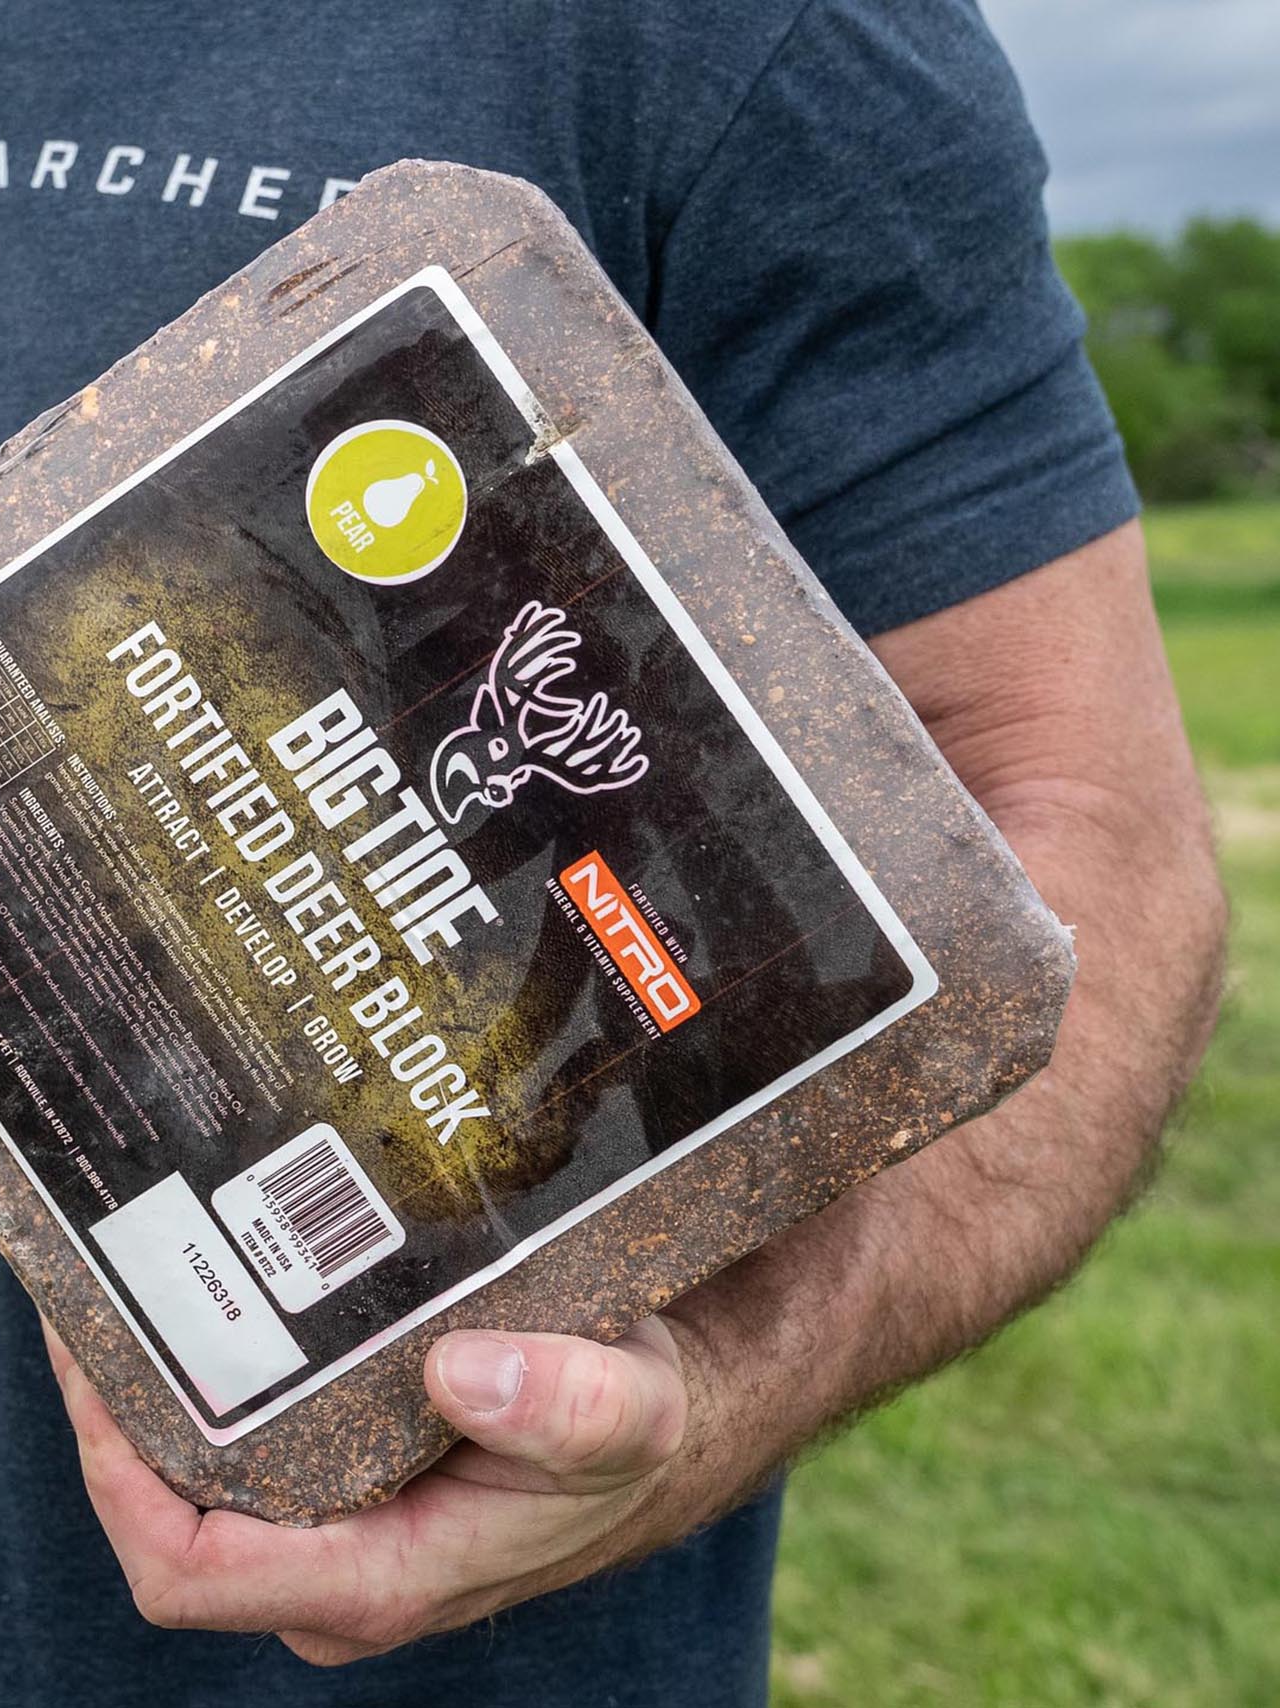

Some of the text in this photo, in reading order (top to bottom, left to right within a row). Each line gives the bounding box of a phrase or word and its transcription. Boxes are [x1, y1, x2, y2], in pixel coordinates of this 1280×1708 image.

[328, 499, 376, 553] PEAR
[28, 696, 68, 747] ANALYSIS:
[55, 761, 80, 792] heavily
[66, 753, 119, 823] INSTRUCTIONS:
[75, 789, 92, 810] used
[86, 808, 106, 831] trails,
[264, 686, 499, 967] BIG TINE
[101, 829, 121, 853] water
[128, 843, 147, 866] block
[104, 619, 491, 1146] FORTIFIED DEER BLOCK
[142, 865, 154, 876] in
[146, 874, 167, 898] spots
[137, 882, 148, 893] or
[41, 895, 68, 928] Copper
[142, 891, 168, 922] staging
[160, 893, 195, 938] frequented
[20, 883, 36, 902] and
[31, 900, 56, 932] Natural
[51, 929, 67, 947] and
[61, 945, 88, 979] Artificial
[43, 770, 263, 1083] game is prohibited in some Consult local laws and regulations before using this
[125, 759, 363, 1086] ATTRACT DEVELOP GROW
[628, 883, 688, 963] FORTIFIED WITH
[7, 796, 38, 836] Sunflower
[50, 859, 73, 888] Whole
[82, 906, 108, 939] Brewers
[103, 937, 123, 961] Dried
[146, 999, 172, 1033] Calcium
[197, 1074, 213, 1092] Iron
[18, 787, 67, 852] INGREDIENTS:
[61, 852, 84, 881] Whole
[94, 901, 123, 938] Molasses
[141, 970, 172, 1010] Processed
[167, 1008, 188, 1033] Grain
[215, 1077, 235, 1102] Black
[230, 1099, 244, 1115] Oil
[179, 943, 197, 963] Can
[188, 934, 202, 948] by
[567, 861, 693, 1021] NITRO
[192, 960, 205, 974] be
[544, 877, 661, 1041] MINERAL & VITAMIN SUPPLEMENT
[33, 857, 73, 910] Monocalcium
[93, 949, 130, 997] Magnesium
[144, 1020, 160, 1038] Iron
[182, 1075, 200, 1095] Zinc
[199, 972, 218, 993] used
[211, 966, 229, 986] such
[19, 994, 33, 1012] was
[222, 985, 236, 999] as,
[232, 996, 250, 1016] field
[5, 917, 23, 938] feed
[18, 936, 28, 946] to
[40, 969, 66, 1001] Product
[102, 1058, 122, 1084] which
[117, 1081, 126, 1090] is
[135, 1108, 145, 1119] to
[54, 1045, 65, 1056] in
[60, 1055, 68, 1063] a
[243, 1036, 258, 1053] The
[261, 1040, 284, 1067] feeder
[63, 1060, 87, 1089] facility
[251, 1050, 278, 1083] feeding
[278, 1065, 297, 1087] sites,
[81, 1085, 97, 1103] that
[272, 1079, 285, 1091] of
[92, 1100, 108, 1119] also
[13, 1064, 49, 1110] ROCKVILLE,
[43, 1107, 56, 1119] IN
[50, 1116, 73, 1145] 47872
[75, 1153, 117, 1210] 800.989.4178
[103, 1116, 129, 1149] handles
[245, 1174, 330, 1290] 0 15958 99341 0
[251, 1217, 293, 1272] MADE IN USA
[241, 1231, 276, 1278] ITEM # BT22
[180, 1240, 242, 1322] 11226318
